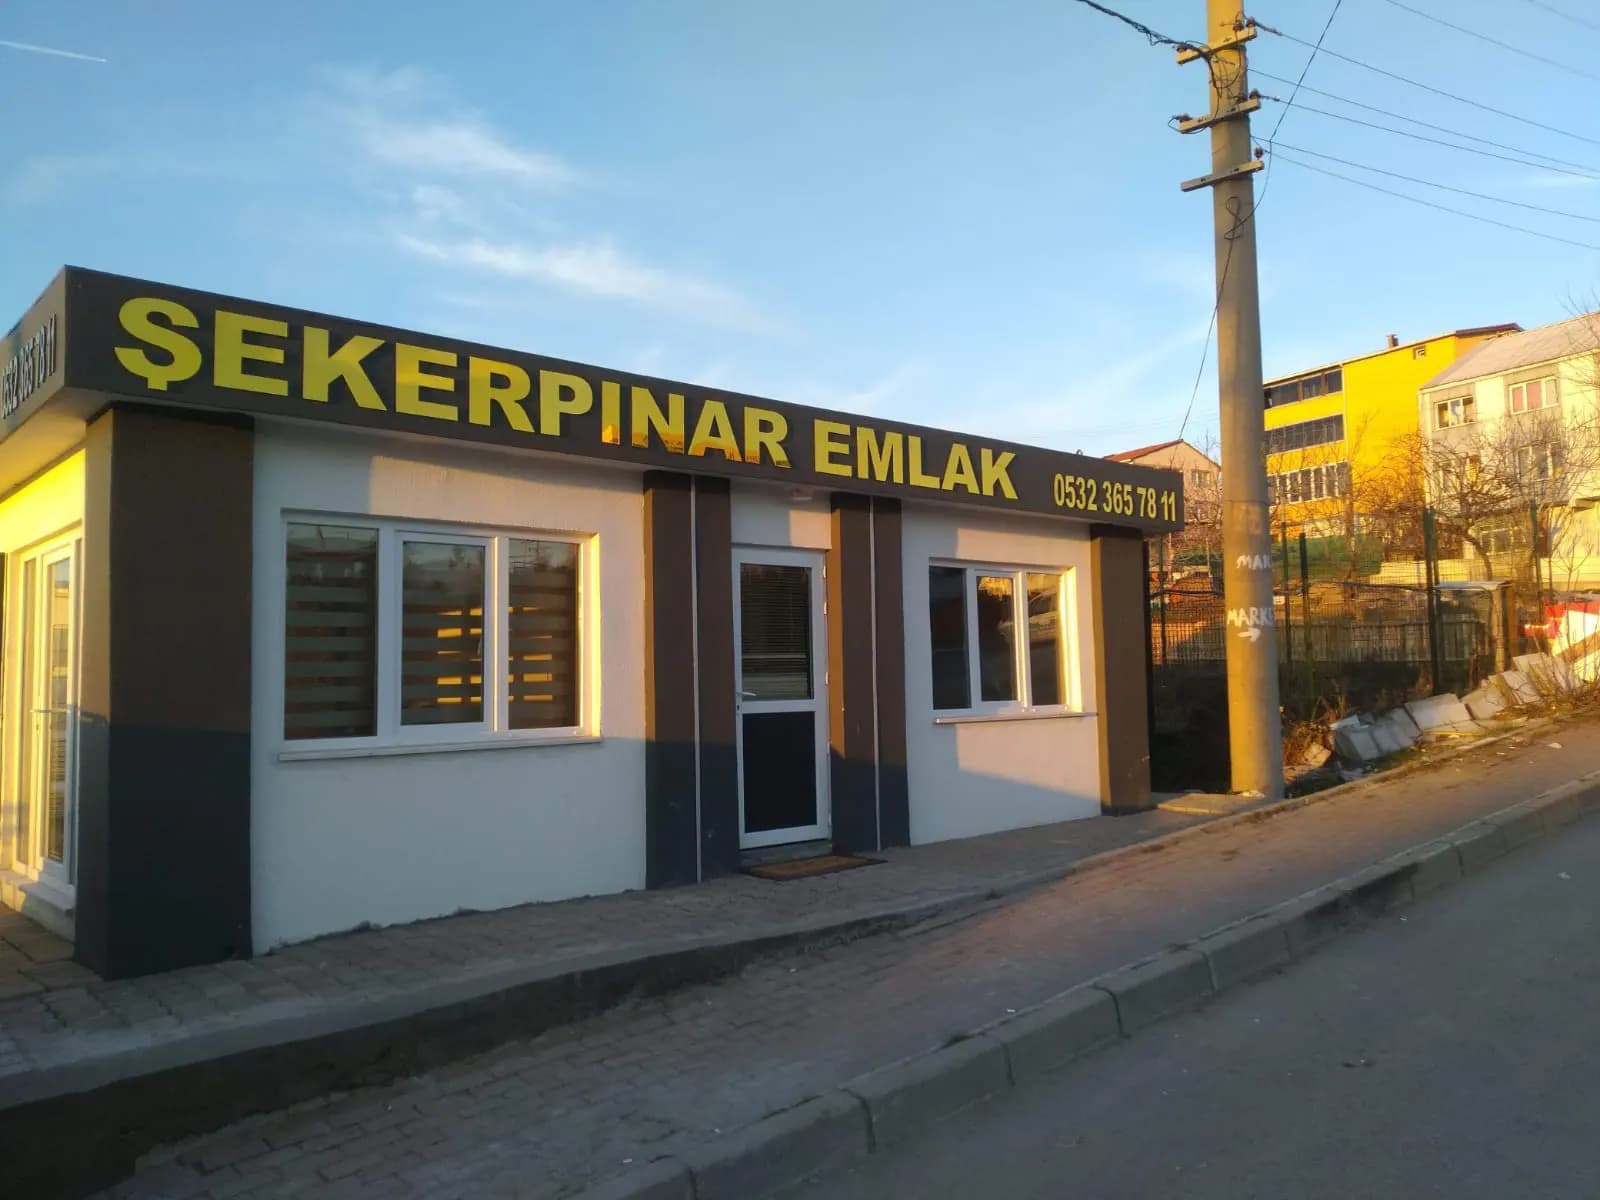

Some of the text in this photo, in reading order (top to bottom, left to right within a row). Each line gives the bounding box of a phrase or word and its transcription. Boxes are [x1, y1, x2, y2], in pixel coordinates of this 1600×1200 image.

[114, 297, 1018, 500] ŞEKERPINAR EMLAK
[1053, 473, 1177, 522] 0532 365 78 11
